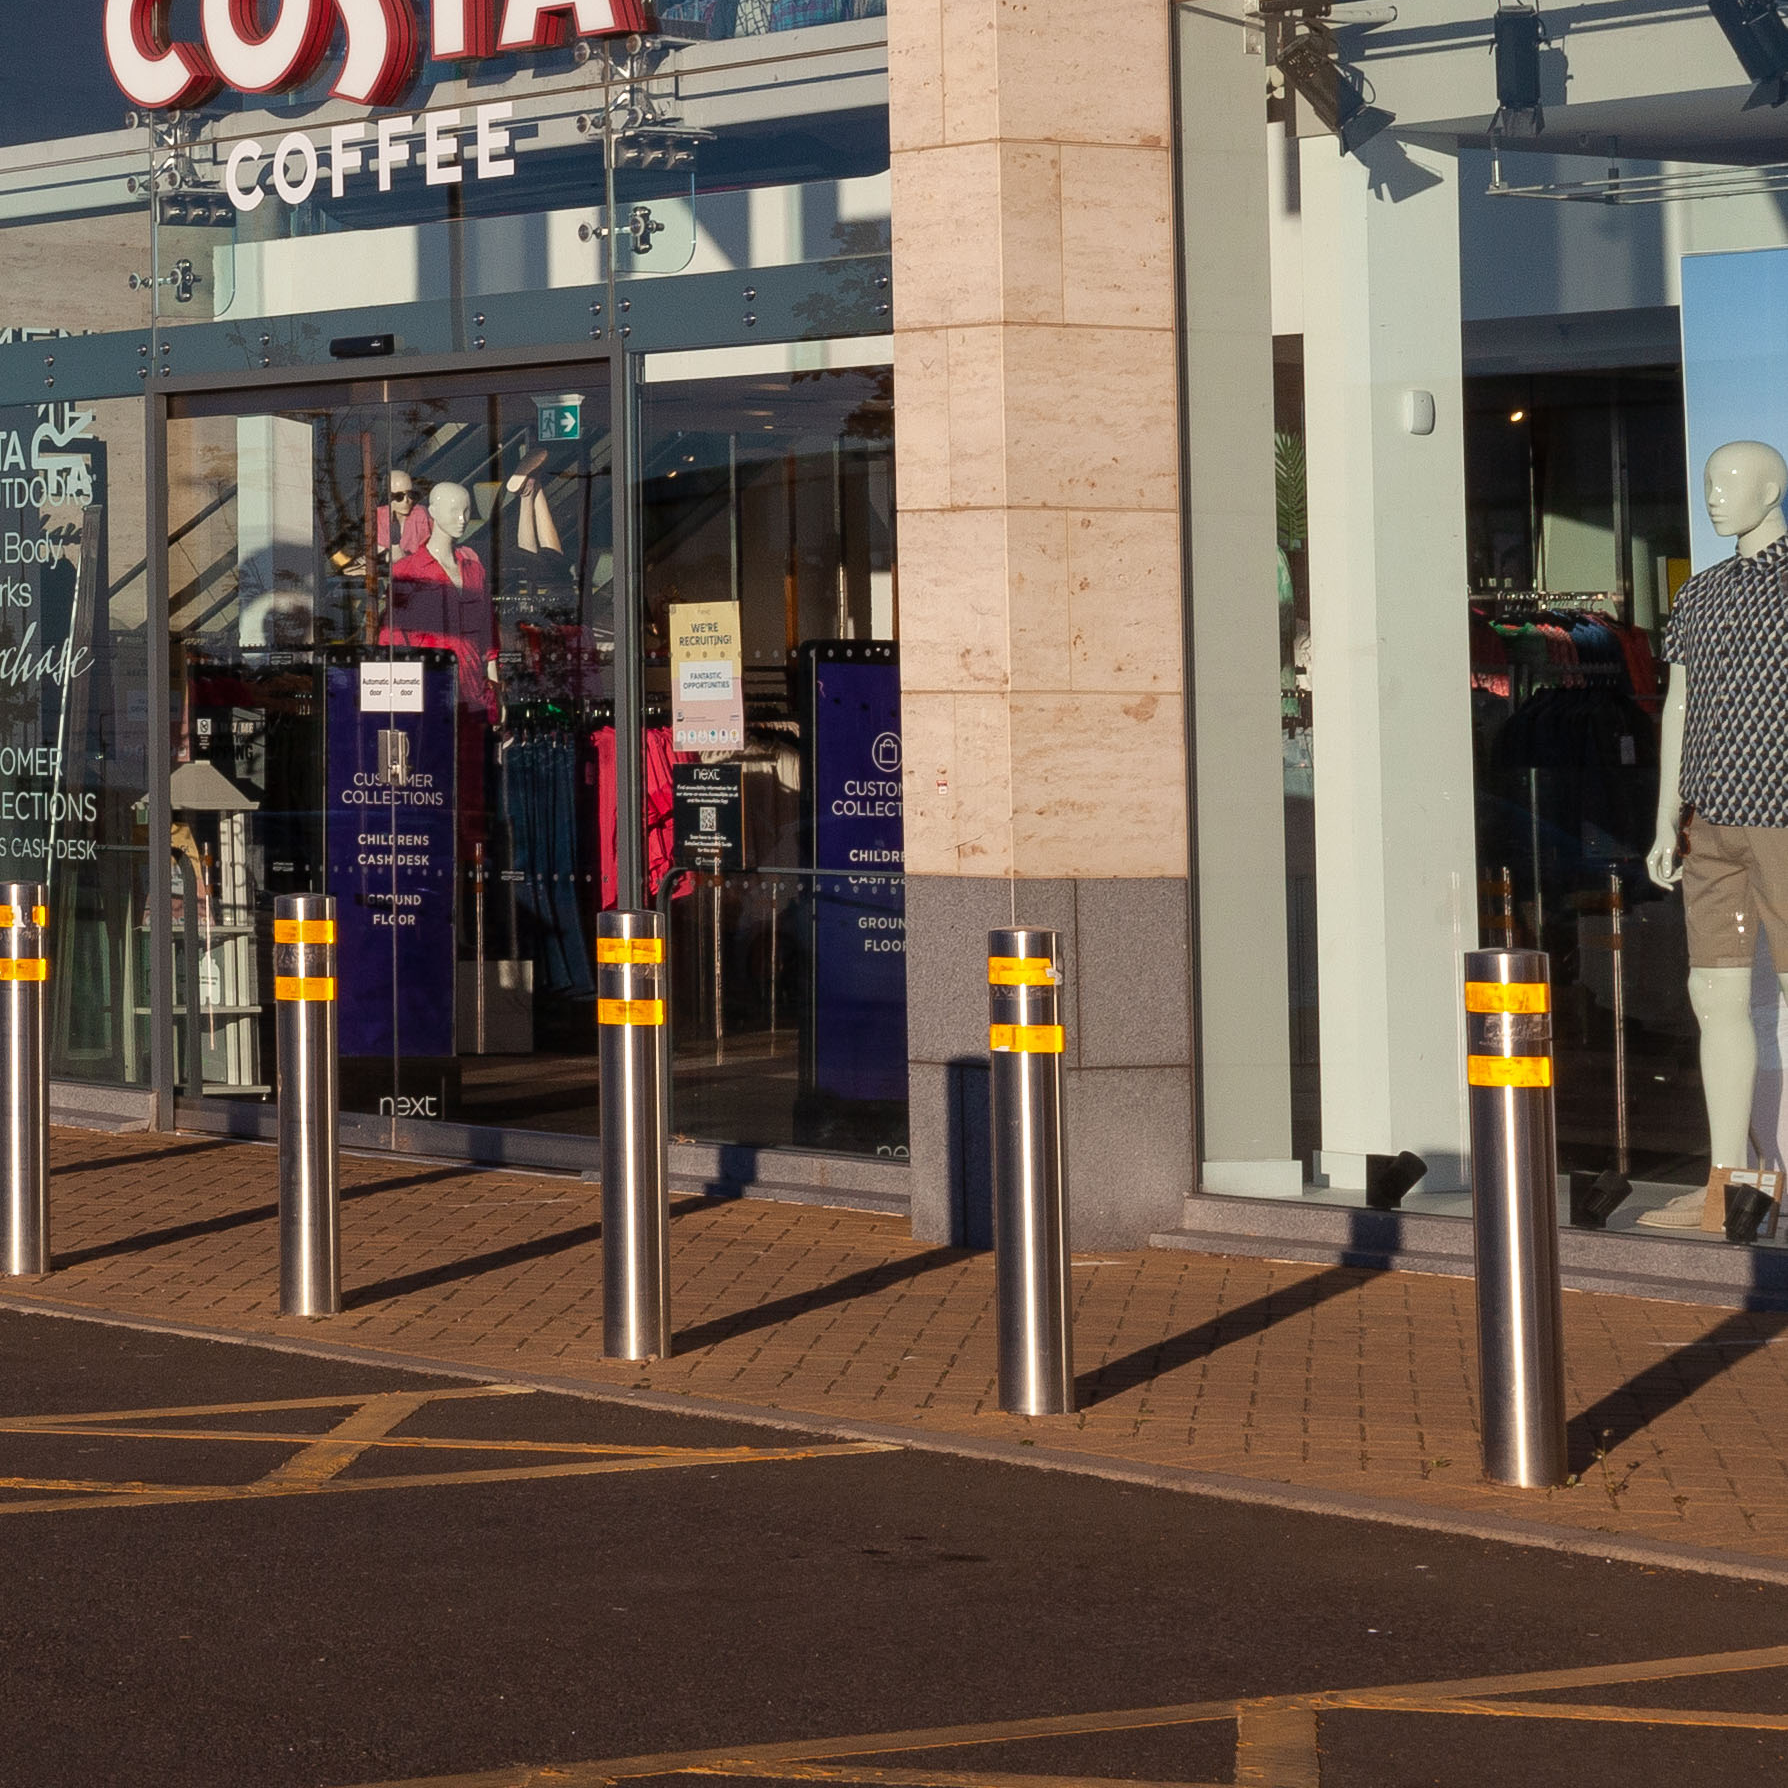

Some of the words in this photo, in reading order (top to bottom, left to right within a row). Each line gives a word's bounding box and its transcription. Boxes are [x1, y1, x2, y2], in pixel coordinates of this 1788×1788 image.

[224, 101, 518, 211] COFFEE
[4, 531, 63, 570] Body
[691, 622, 719, 633] WE'RE
[679, 635, 732, 647] RECRUITING!
[362, 677, 390, 686] Automatic
[393, 677, 421, 686] Automatic
[690, 672, 722, 680] FANTASTIC
[683, 680, 731, 690] OPPORTUNITIES
[353, 772, 433, 788] CUSMER
[693, 768, 721, 781] next
[844, 780, 903, 797] CUSTO
[341, 790, 444, 806] COLLECTIONS
[832, 800, 903, 817] COLLECT
[357, 833, 430, 846] CHILDRENS
[10, 837, 51, 859] CASH
[56, 839, 97, 861] DESK
[357, 853, 393, 865] CASH
[397, 854, 430, 866] DESK
[367, 894, 422, 906] GROUND
[373, 914, 416, 926] FLOOR
[858, 916, 905, 930] GROUN
[379, 1095, 438, 1117] next
[877, 1145, 910, 1158] ne
